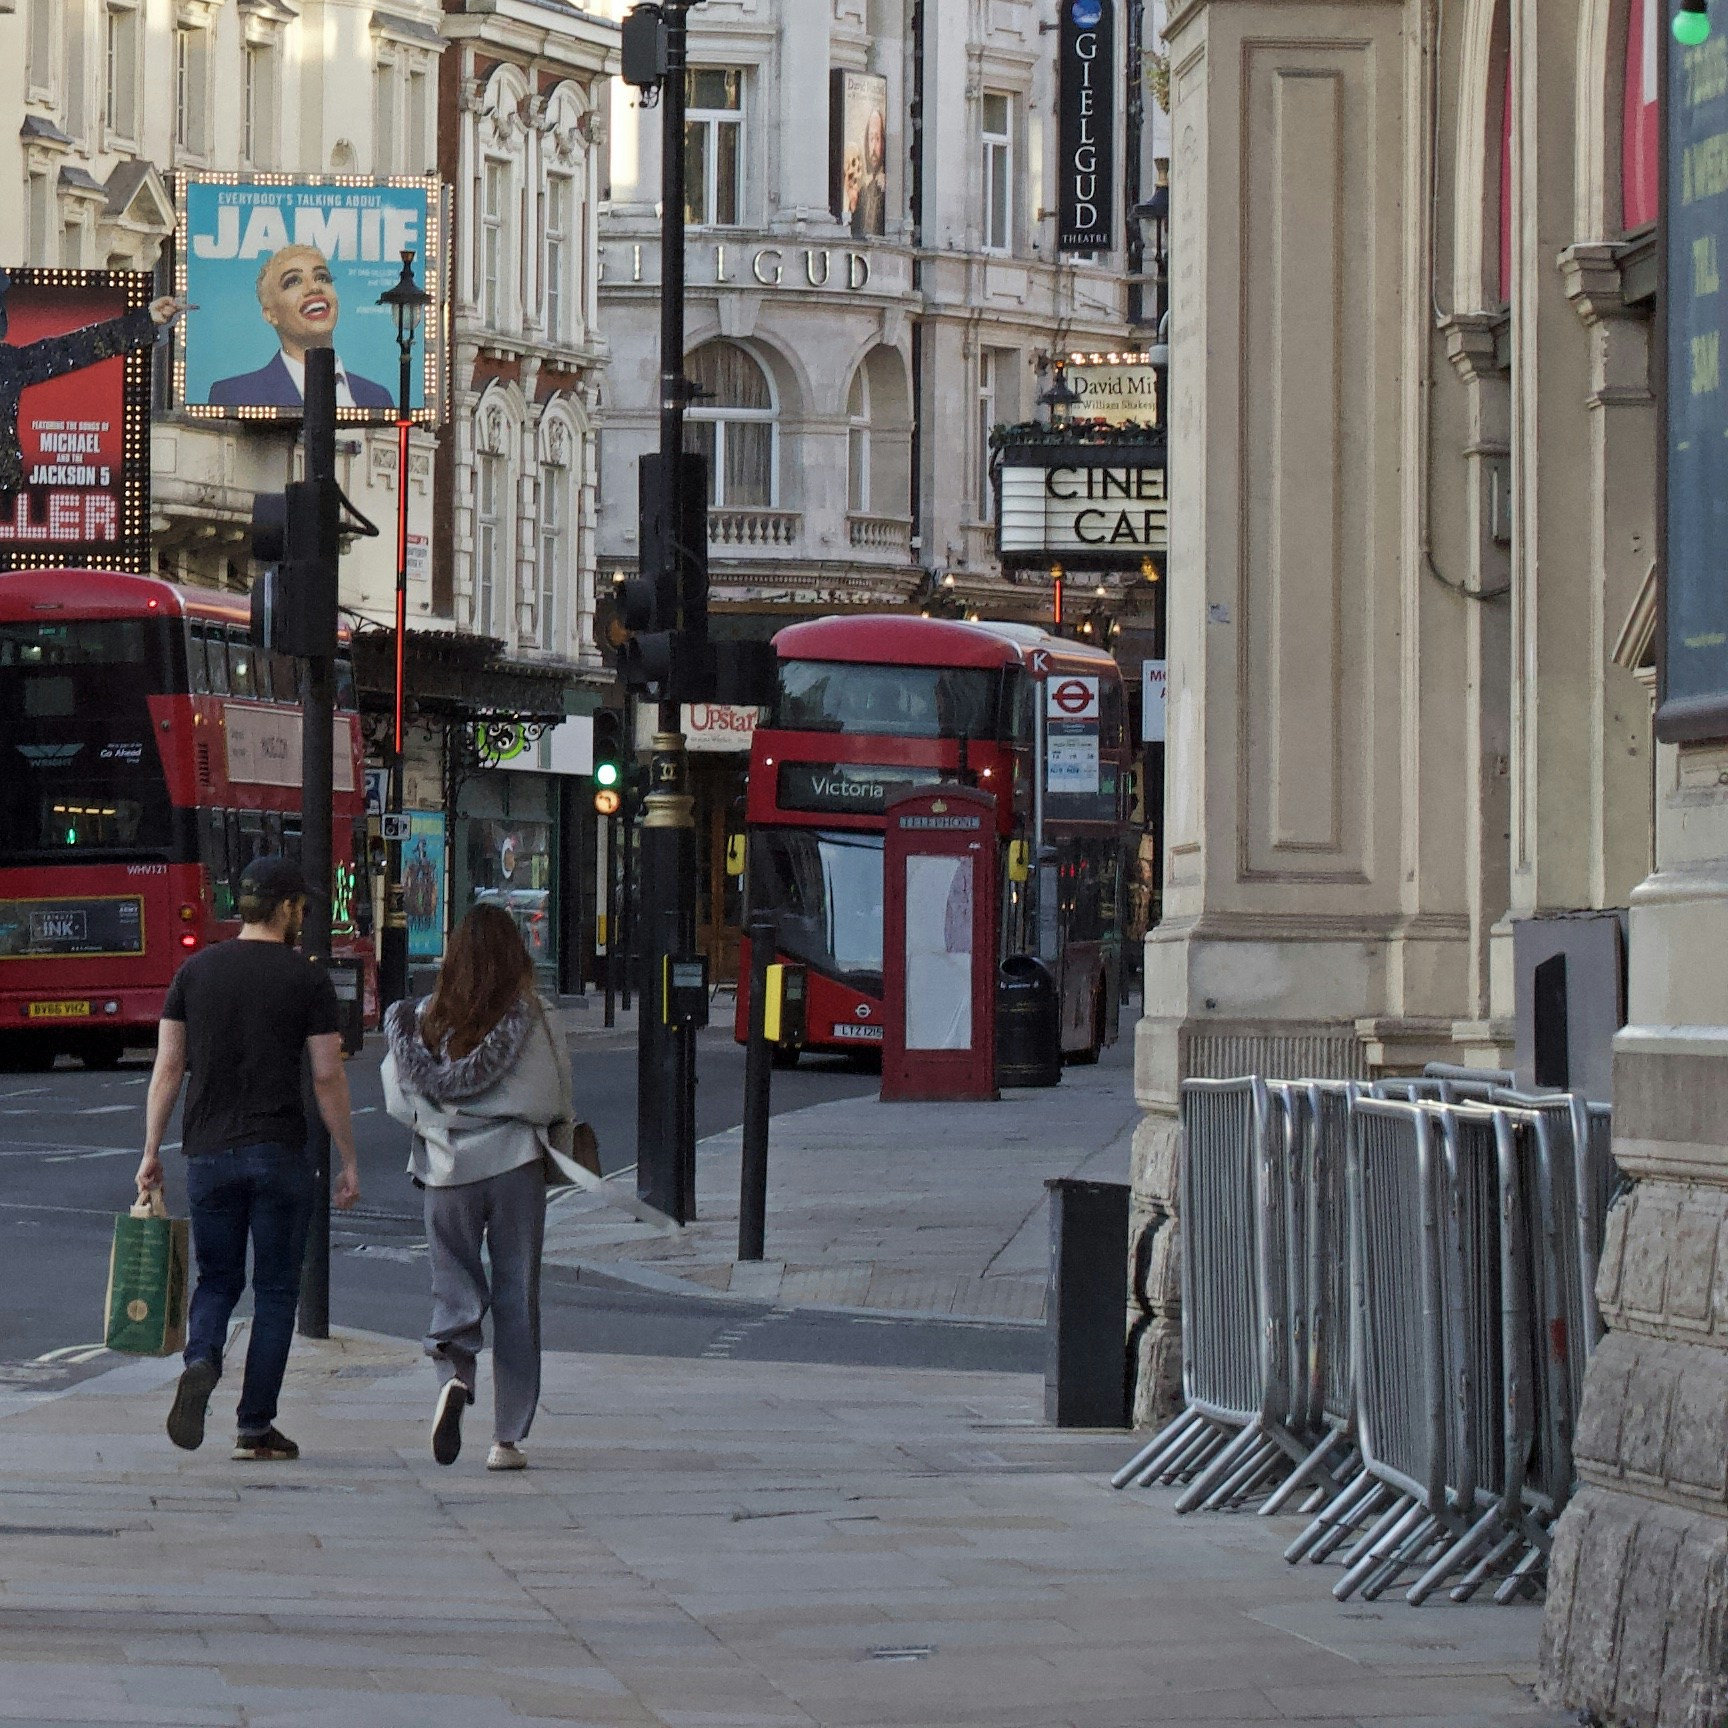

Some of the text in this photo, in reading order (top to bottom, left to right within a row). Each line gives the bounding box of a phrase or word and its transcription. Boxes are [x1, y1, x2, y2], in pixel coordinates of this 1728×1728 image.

[1074, 32, 1097, 229] GIELGUD
[218, 192, 383, 208] EVERYBODY'S TALKING ABOUT
[193, 205, 419, 262] JAMIE
[1062, 233, 1109, 244] THEATRE
[598, 243, 871, 290] ILGUD
[1073, 375, 1122, 395] David
[1083, 401, 1120, 411] William
[39, 432, 101, 453] MICHAEL
[56, 453, 83, 464] AND THE
[29, 464, 110, 486] JACKSON 5
[1046, 464, 1168, 500] CINE
[1033, 652, 1049, 672] K
[811, 776, 884, 798] Victoria
